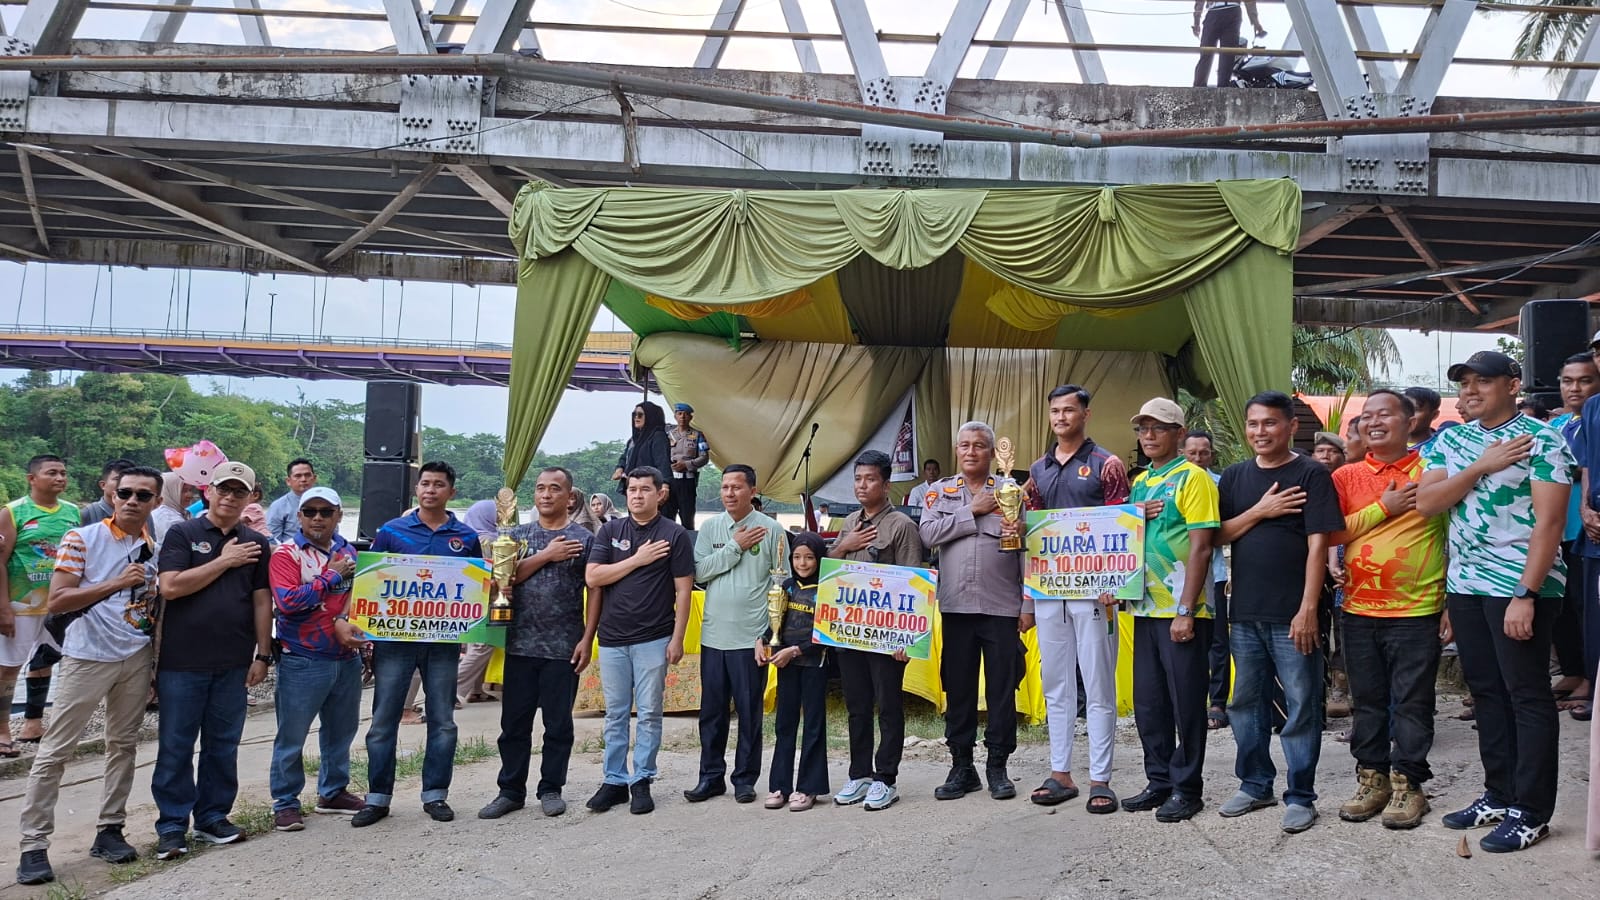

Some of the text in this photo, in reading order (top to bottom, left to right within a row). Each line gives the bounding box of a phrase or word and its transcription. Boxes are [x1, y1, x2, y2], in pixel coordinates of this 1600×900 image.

[1040, 533, 1128, 555] JUARA III
[1030, 554, 1137, 574] Rp. 10.000.000
[380, 579, 464, 600] JUARA I
[1040, 574, 1127, 588] PACU SAMPAN
[355, 598, 483, 619] Rp. 30.000.000
[836, 586, 915, 612] JUARA II
[367, 618, 469, 632] PACU SAMPAN
[820, 603, 928, 633] Rp. 20.000.000
[829, 623, 915, 645] PACU SAMPAN
